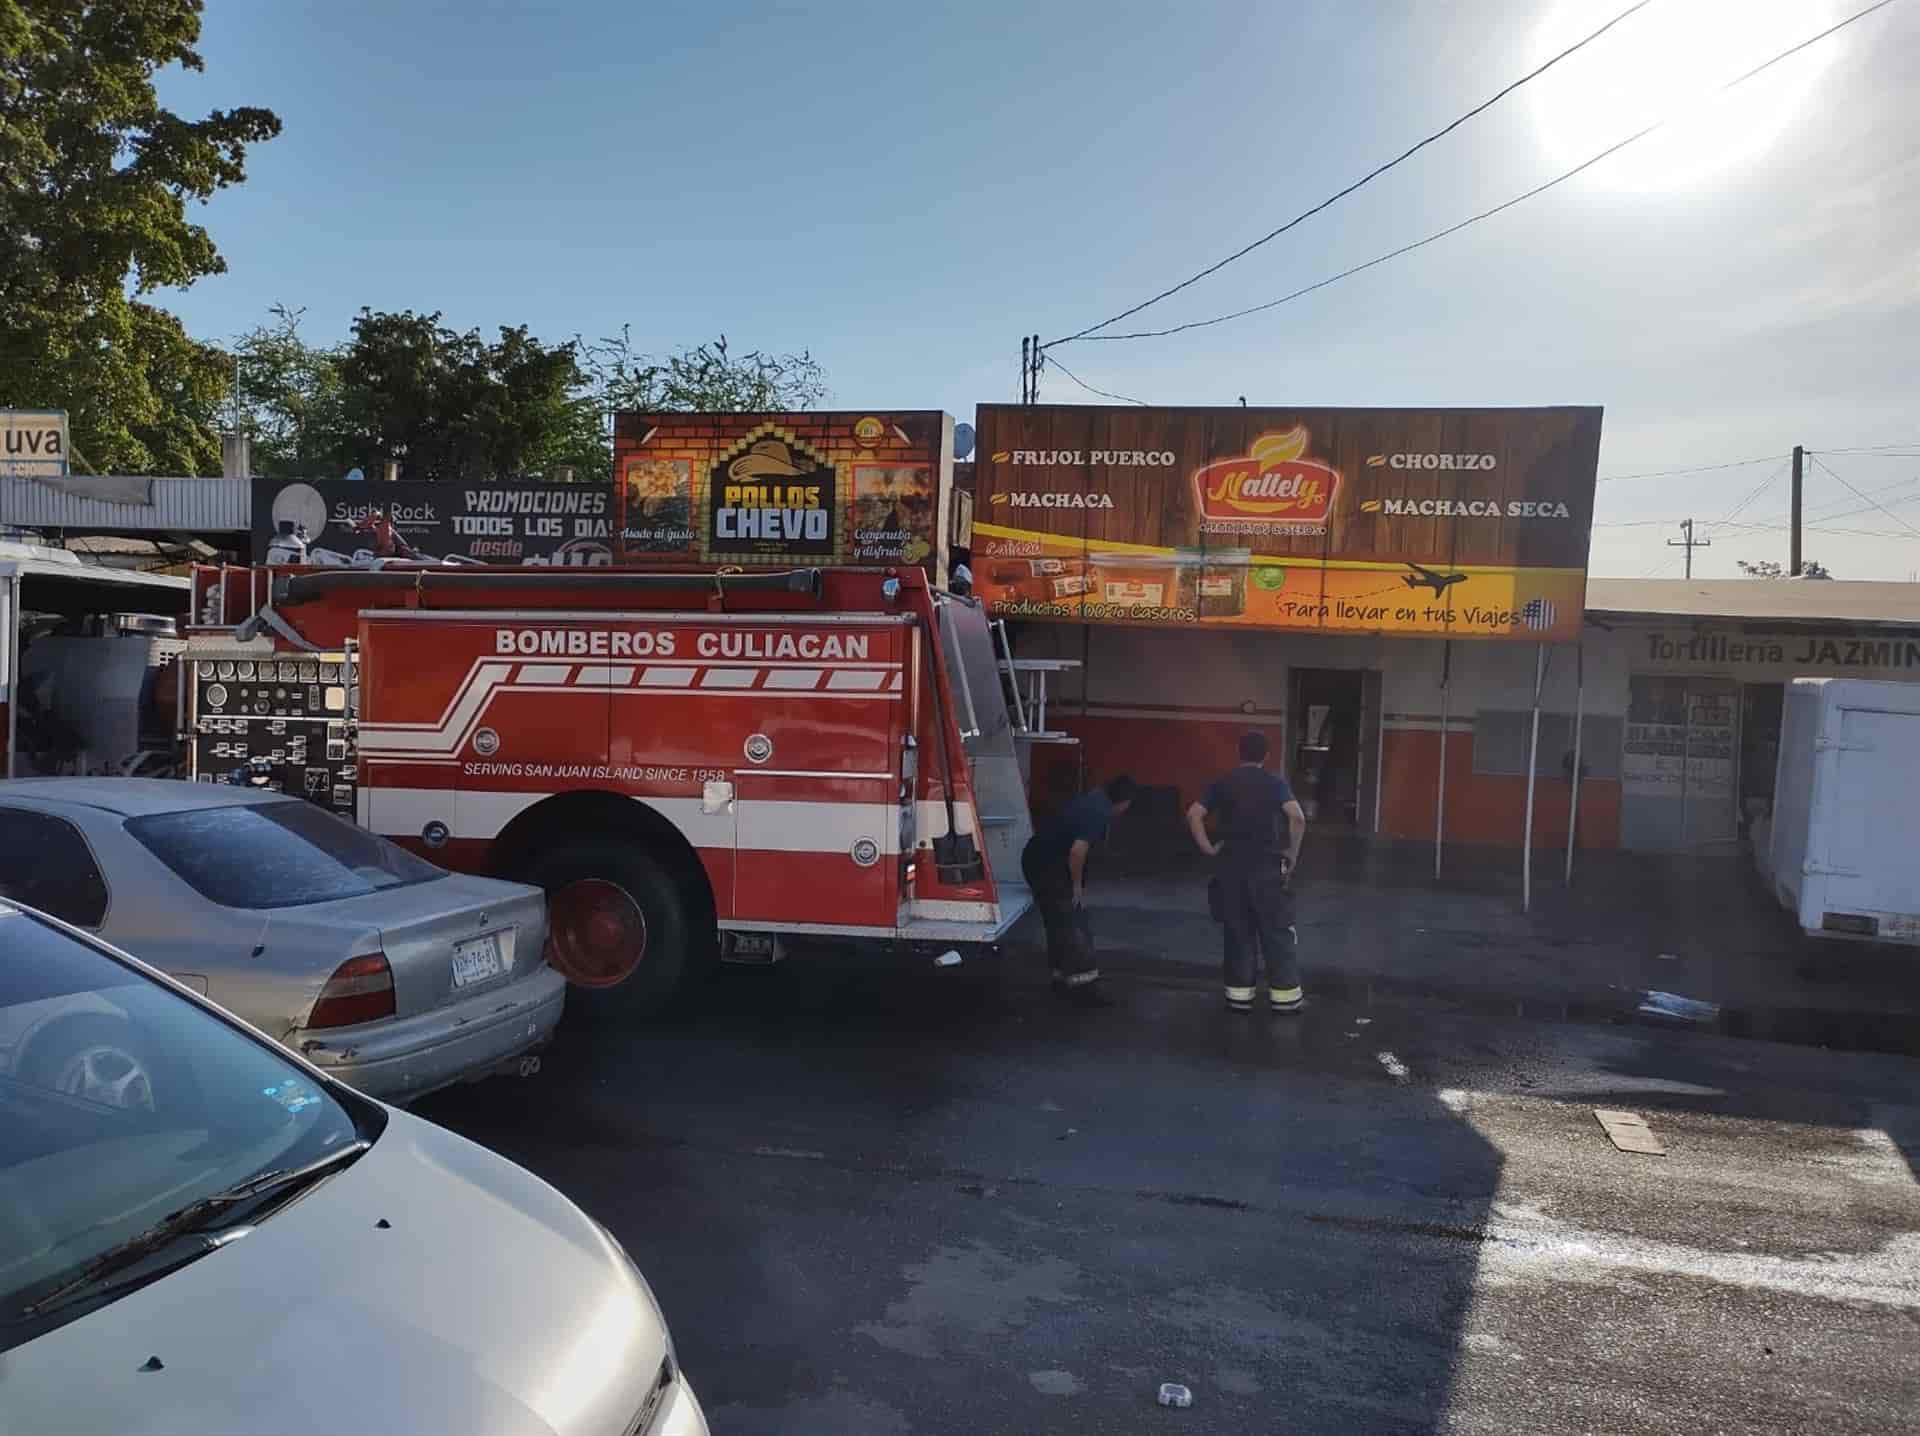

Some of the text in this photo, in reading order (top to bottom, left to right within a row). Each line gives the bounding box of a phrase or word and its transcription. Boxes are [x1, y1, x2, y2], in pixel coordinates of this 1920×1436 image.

[1012, 450, 1176, 466] FRIJOL PUERCO
[1390, 454, 1496, 470] CHORIZO
[465, 490, 607, 513] PROMOCIONES
[724, 486, 821, 508] POLLOS
[1010, 493, 1115, 508] MACHACA
[391, 502, 435, 519] Rock
[1384, 500, 1569, 517] MACHACA SECA
[452, 516, 514, 535] TODOS
[525, 517, 563, 537] LOS
[716, 508, 828, 540] CHEVO
[470, 537, 523, 556] desde
[1285, 601, 1329, 618] Para
[1336, 600, 1390, 621] llevar
[1395, 607, 1416, 621] en
[1423, 606, 1456, 623] tus
[496, 630, 869, 659] BOMBEROS CULIACAN
[464, 763, 725, 783] SERVING SAN JUAN ISLAND SINCE 1958
